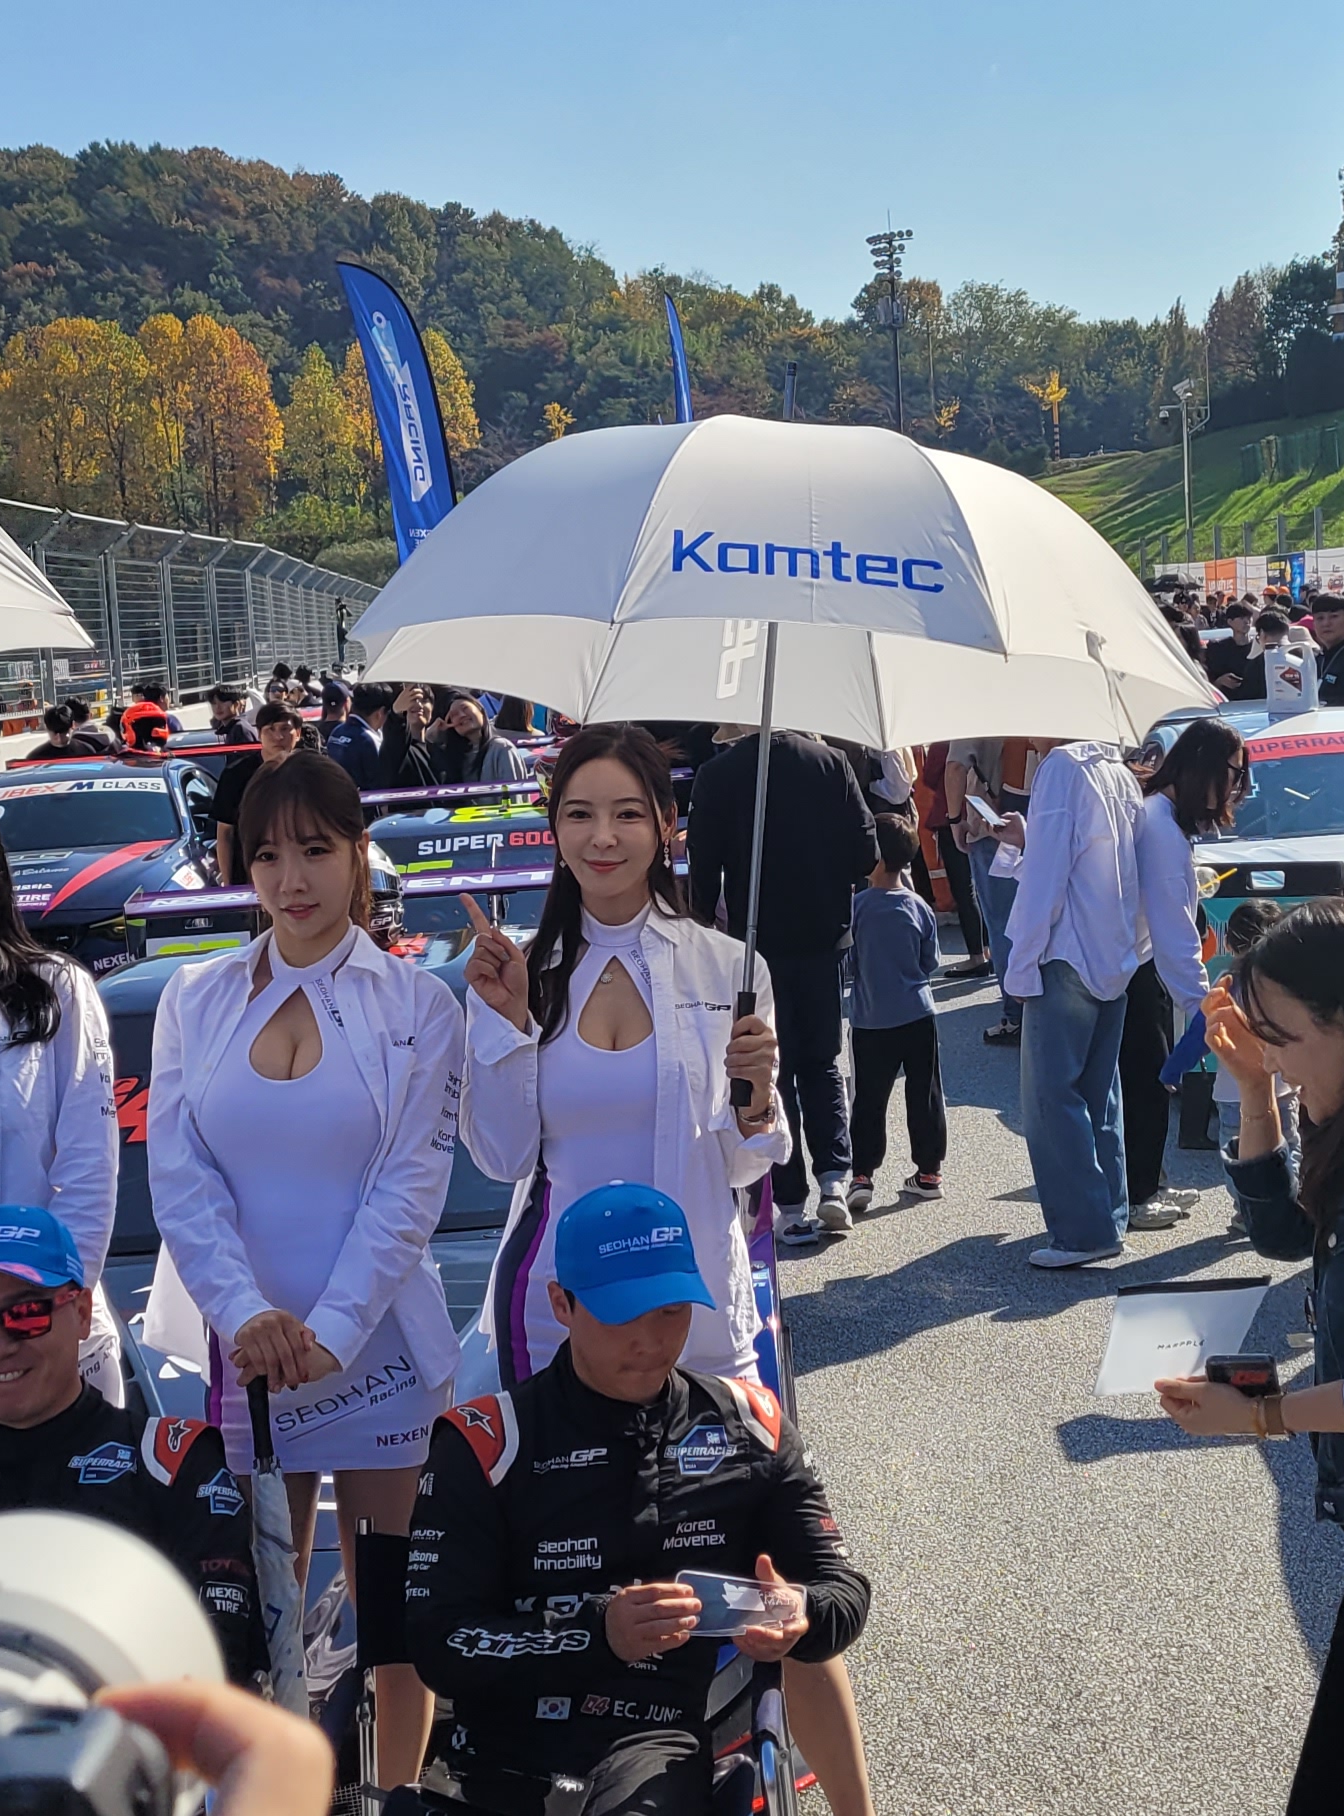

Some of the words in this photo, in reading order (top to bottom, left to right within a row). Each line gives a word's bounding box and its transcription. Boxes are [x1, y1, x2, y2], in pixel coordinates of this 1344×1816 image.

[672, 529, 945, 593] Kamtec
[102, 778, 162, 792] CLASS
[417, 834, 504, 857] SUPER
[92, 953, 137, 973] NEXEN
[598, 1235, 651, 1255] SEOHAN
[651, 1226, 683, 1244] GP
[275, 1353, 414, 1434] SEOHAN
[368, 1374, 418, 1407] Racing
[376, 1424, 430, 1448] NEXEN
[569, 1447, 608, 1463] GP
[676, 1519, 716, 1535] Korea
[537, 1537, 598, 1554] Seohan
[662, 1533, 726, 1551] Movenex
[533, 1555, 602, 1571] Innobility
[613, 1701, 645, 1720] EC.
